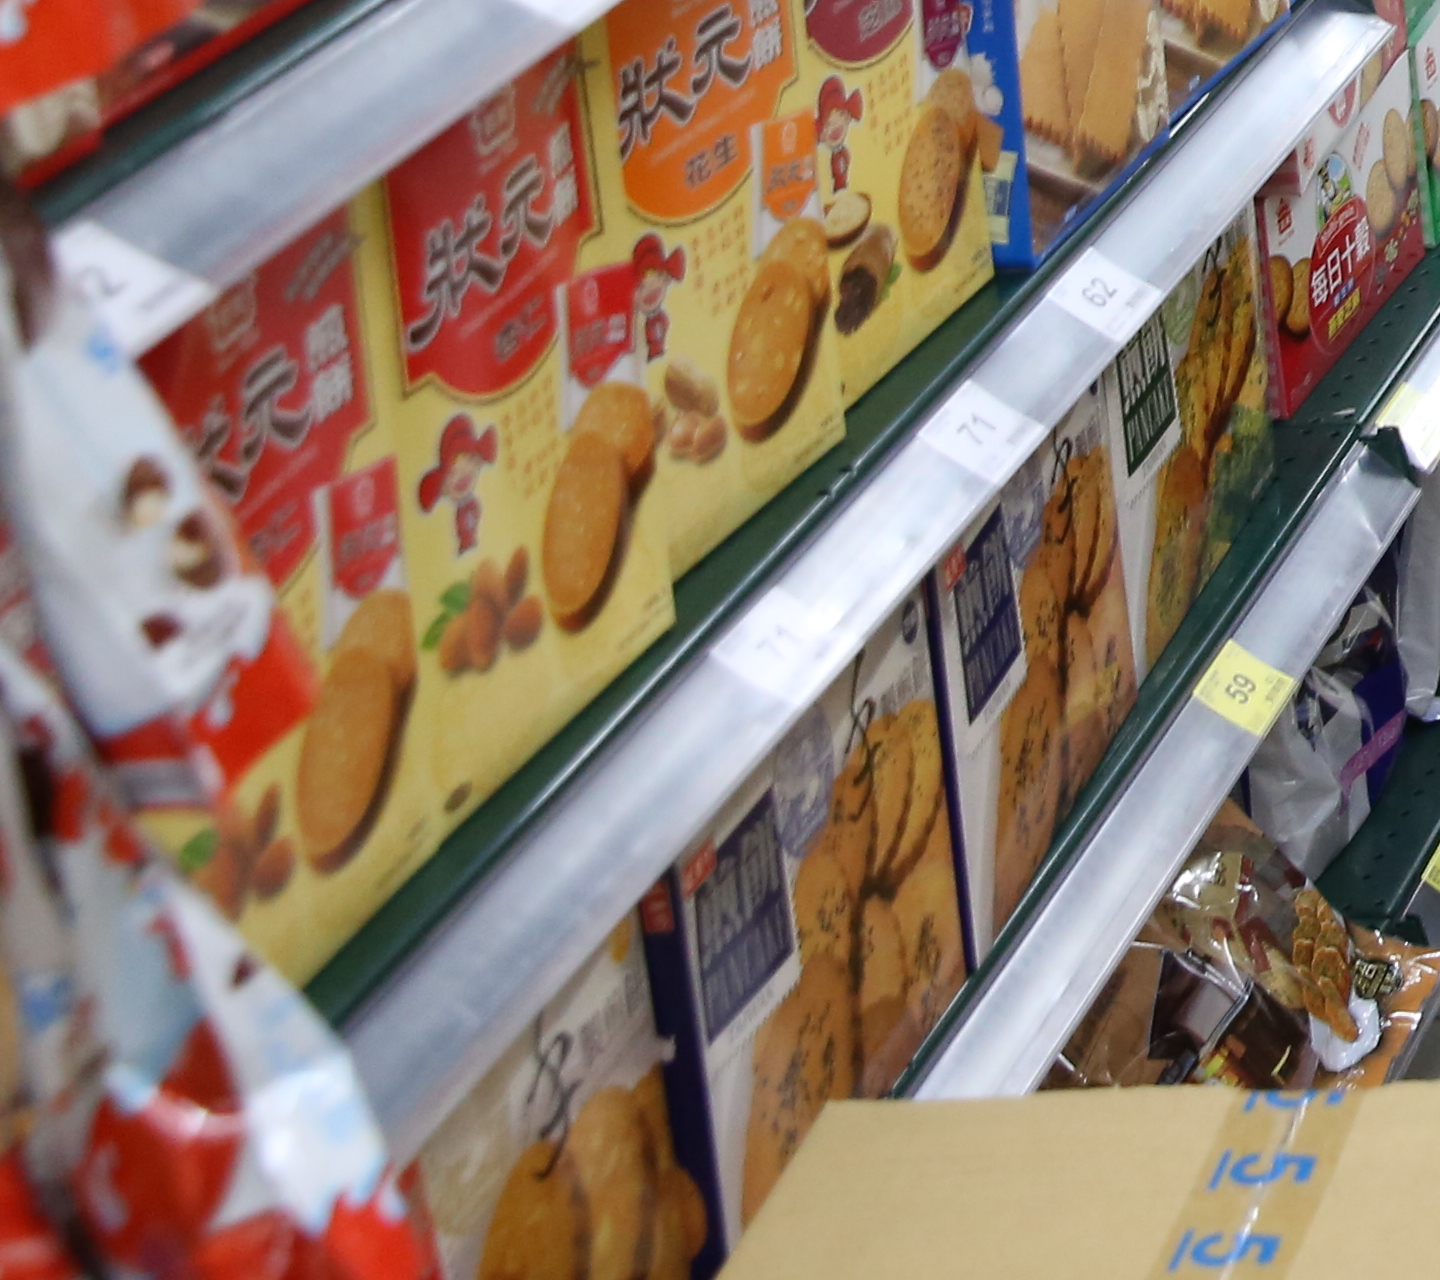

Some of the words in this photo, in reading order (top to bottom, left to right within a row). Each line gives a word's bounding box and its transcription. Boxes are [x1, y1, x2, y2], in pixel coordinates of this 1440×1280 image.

[619, 6, 749, 159] 狀元
[408, 157, 552, 350] 狀元
[1310, 217, 1370, 308] 每日十穀
[1225, 670, 1257, 707] 59
